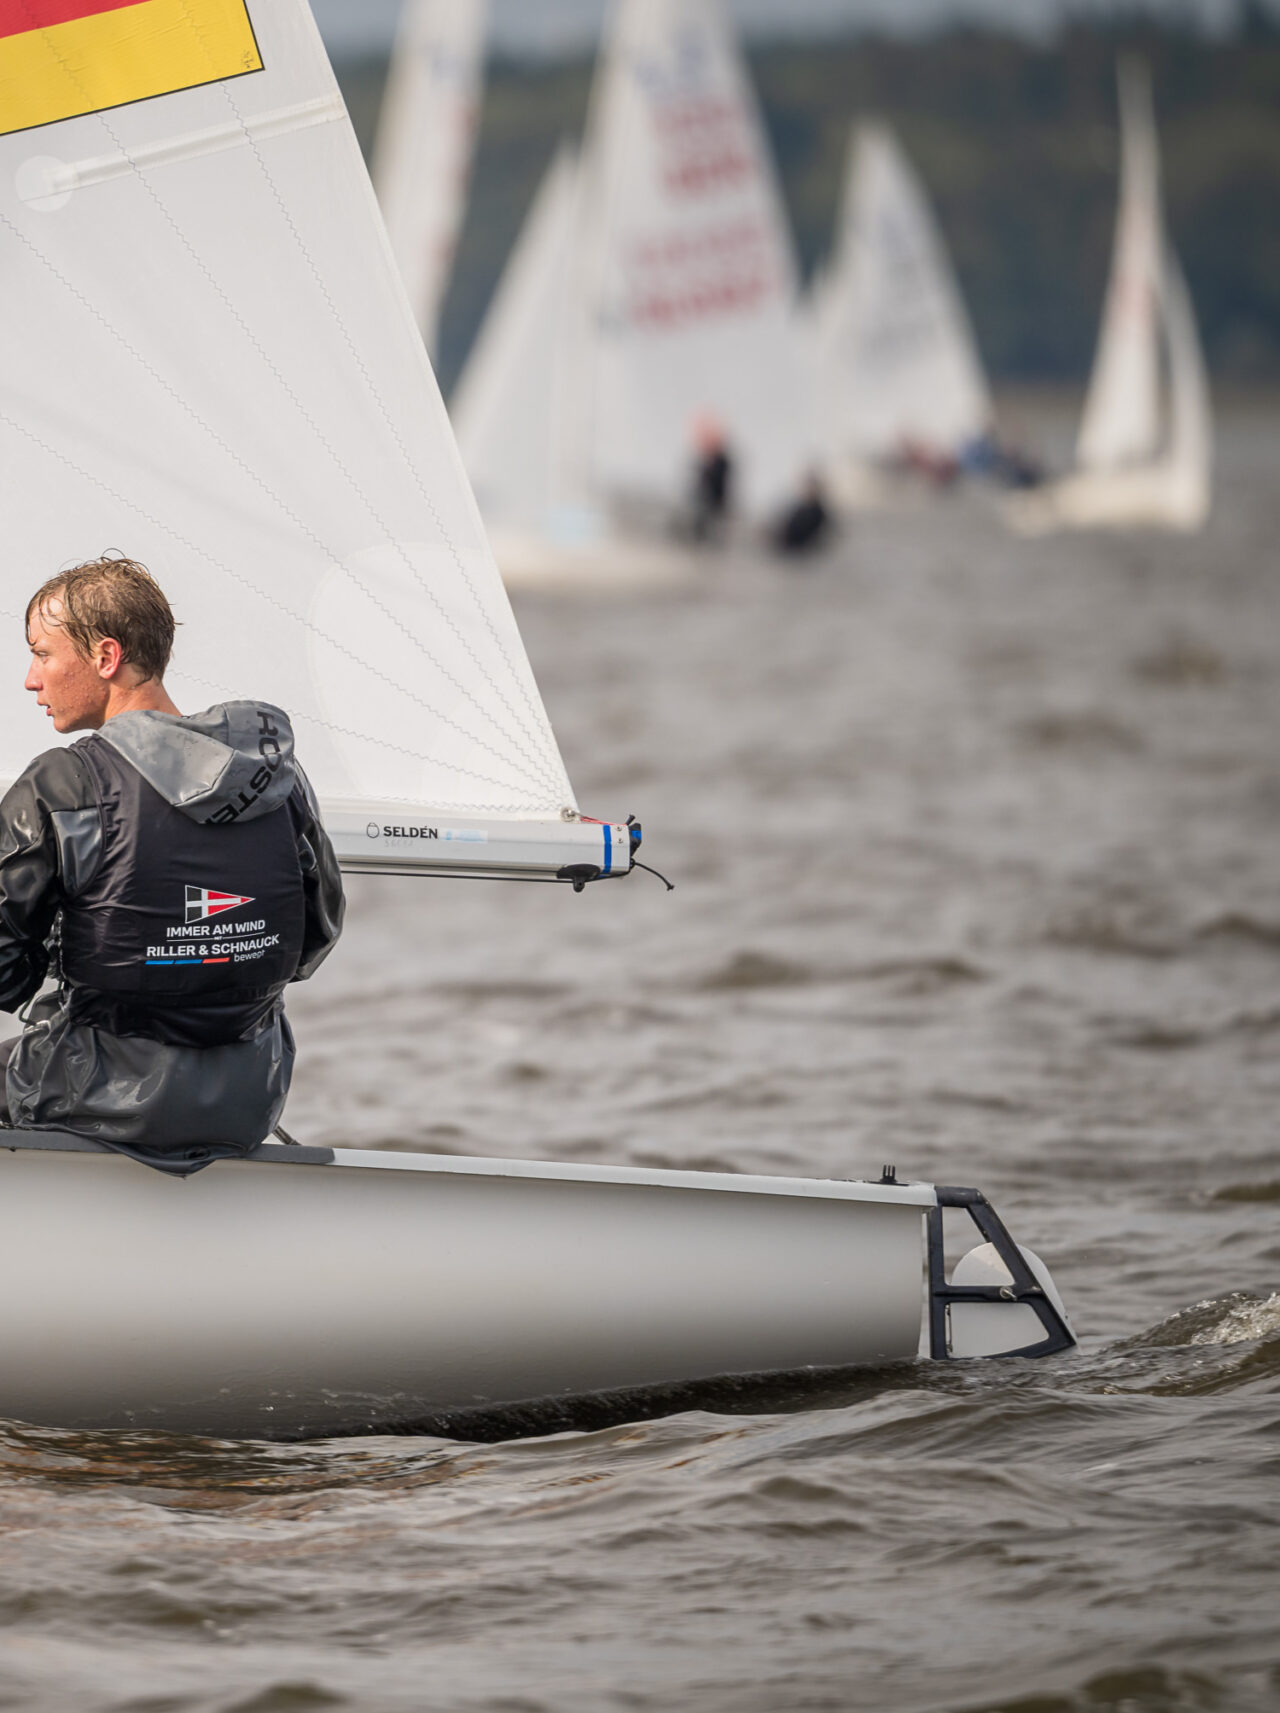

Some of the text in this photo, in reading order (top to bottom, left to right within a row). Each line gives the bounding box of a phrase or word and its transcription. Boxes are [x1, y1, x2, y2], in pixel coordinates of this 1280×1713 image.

[383, 825, 439, 840] SELDÉN
[166, 919, 266, 937] IMMER AM WIND
[146, 934, 280, 957] RILLER & SCHNAUCK
